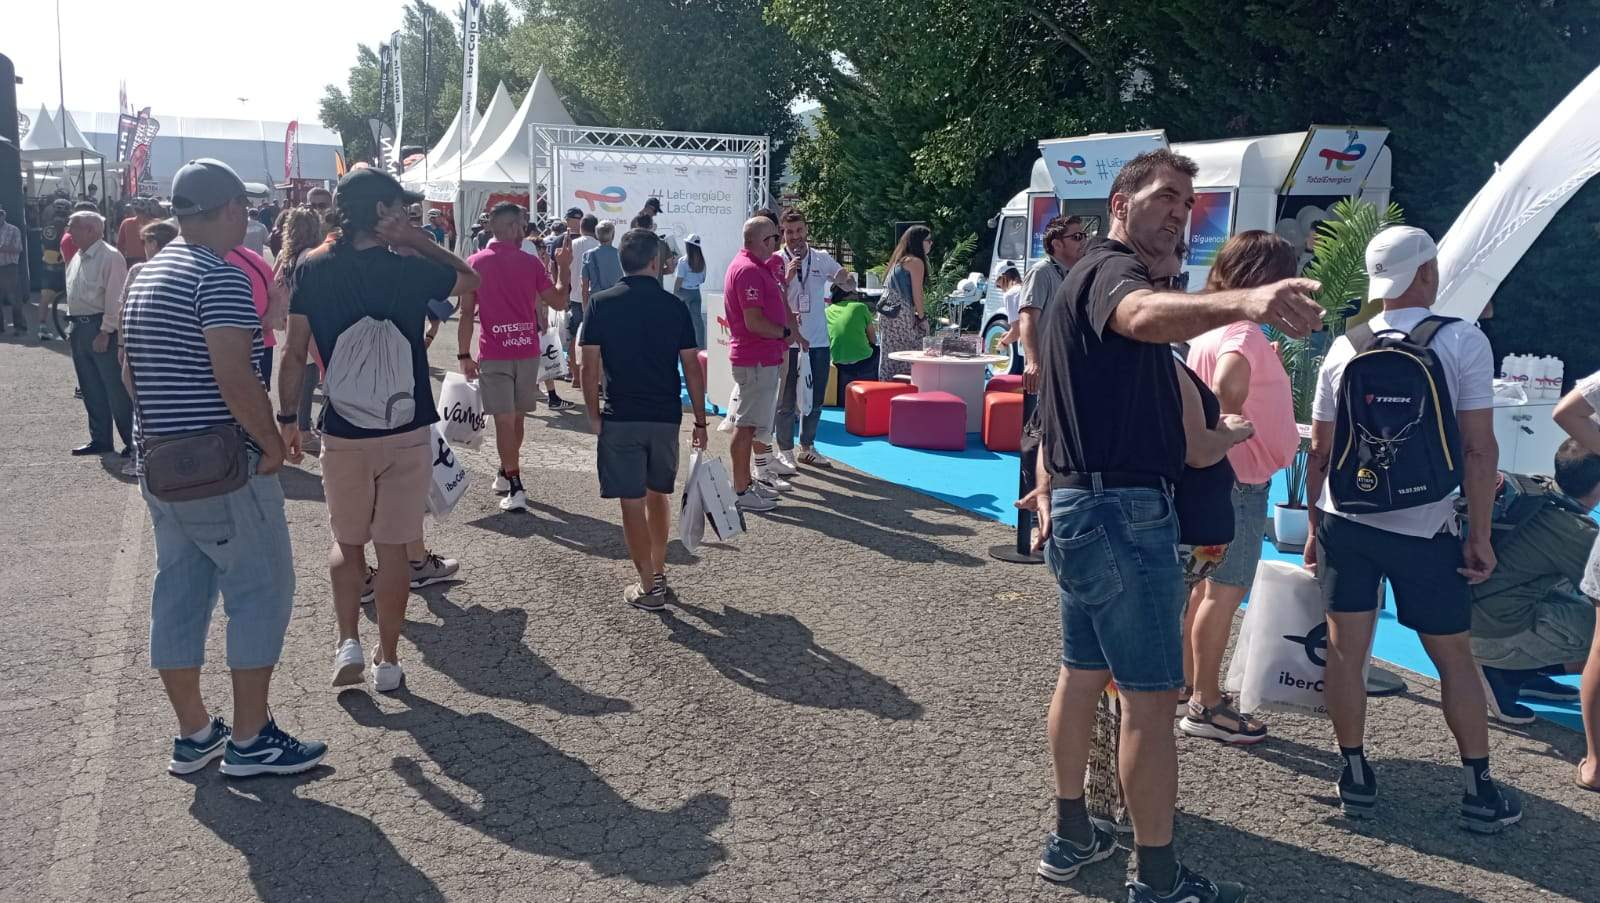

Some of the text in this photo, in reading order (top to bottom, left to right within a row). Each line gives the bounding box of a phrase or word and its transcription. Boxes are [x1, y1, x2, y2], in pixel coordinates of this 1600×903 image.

[466, 21, 479, 78] iberCaja
[667, 201, 732, 214] LasCarreras
[1279, 671, 1325, 692] iberC
